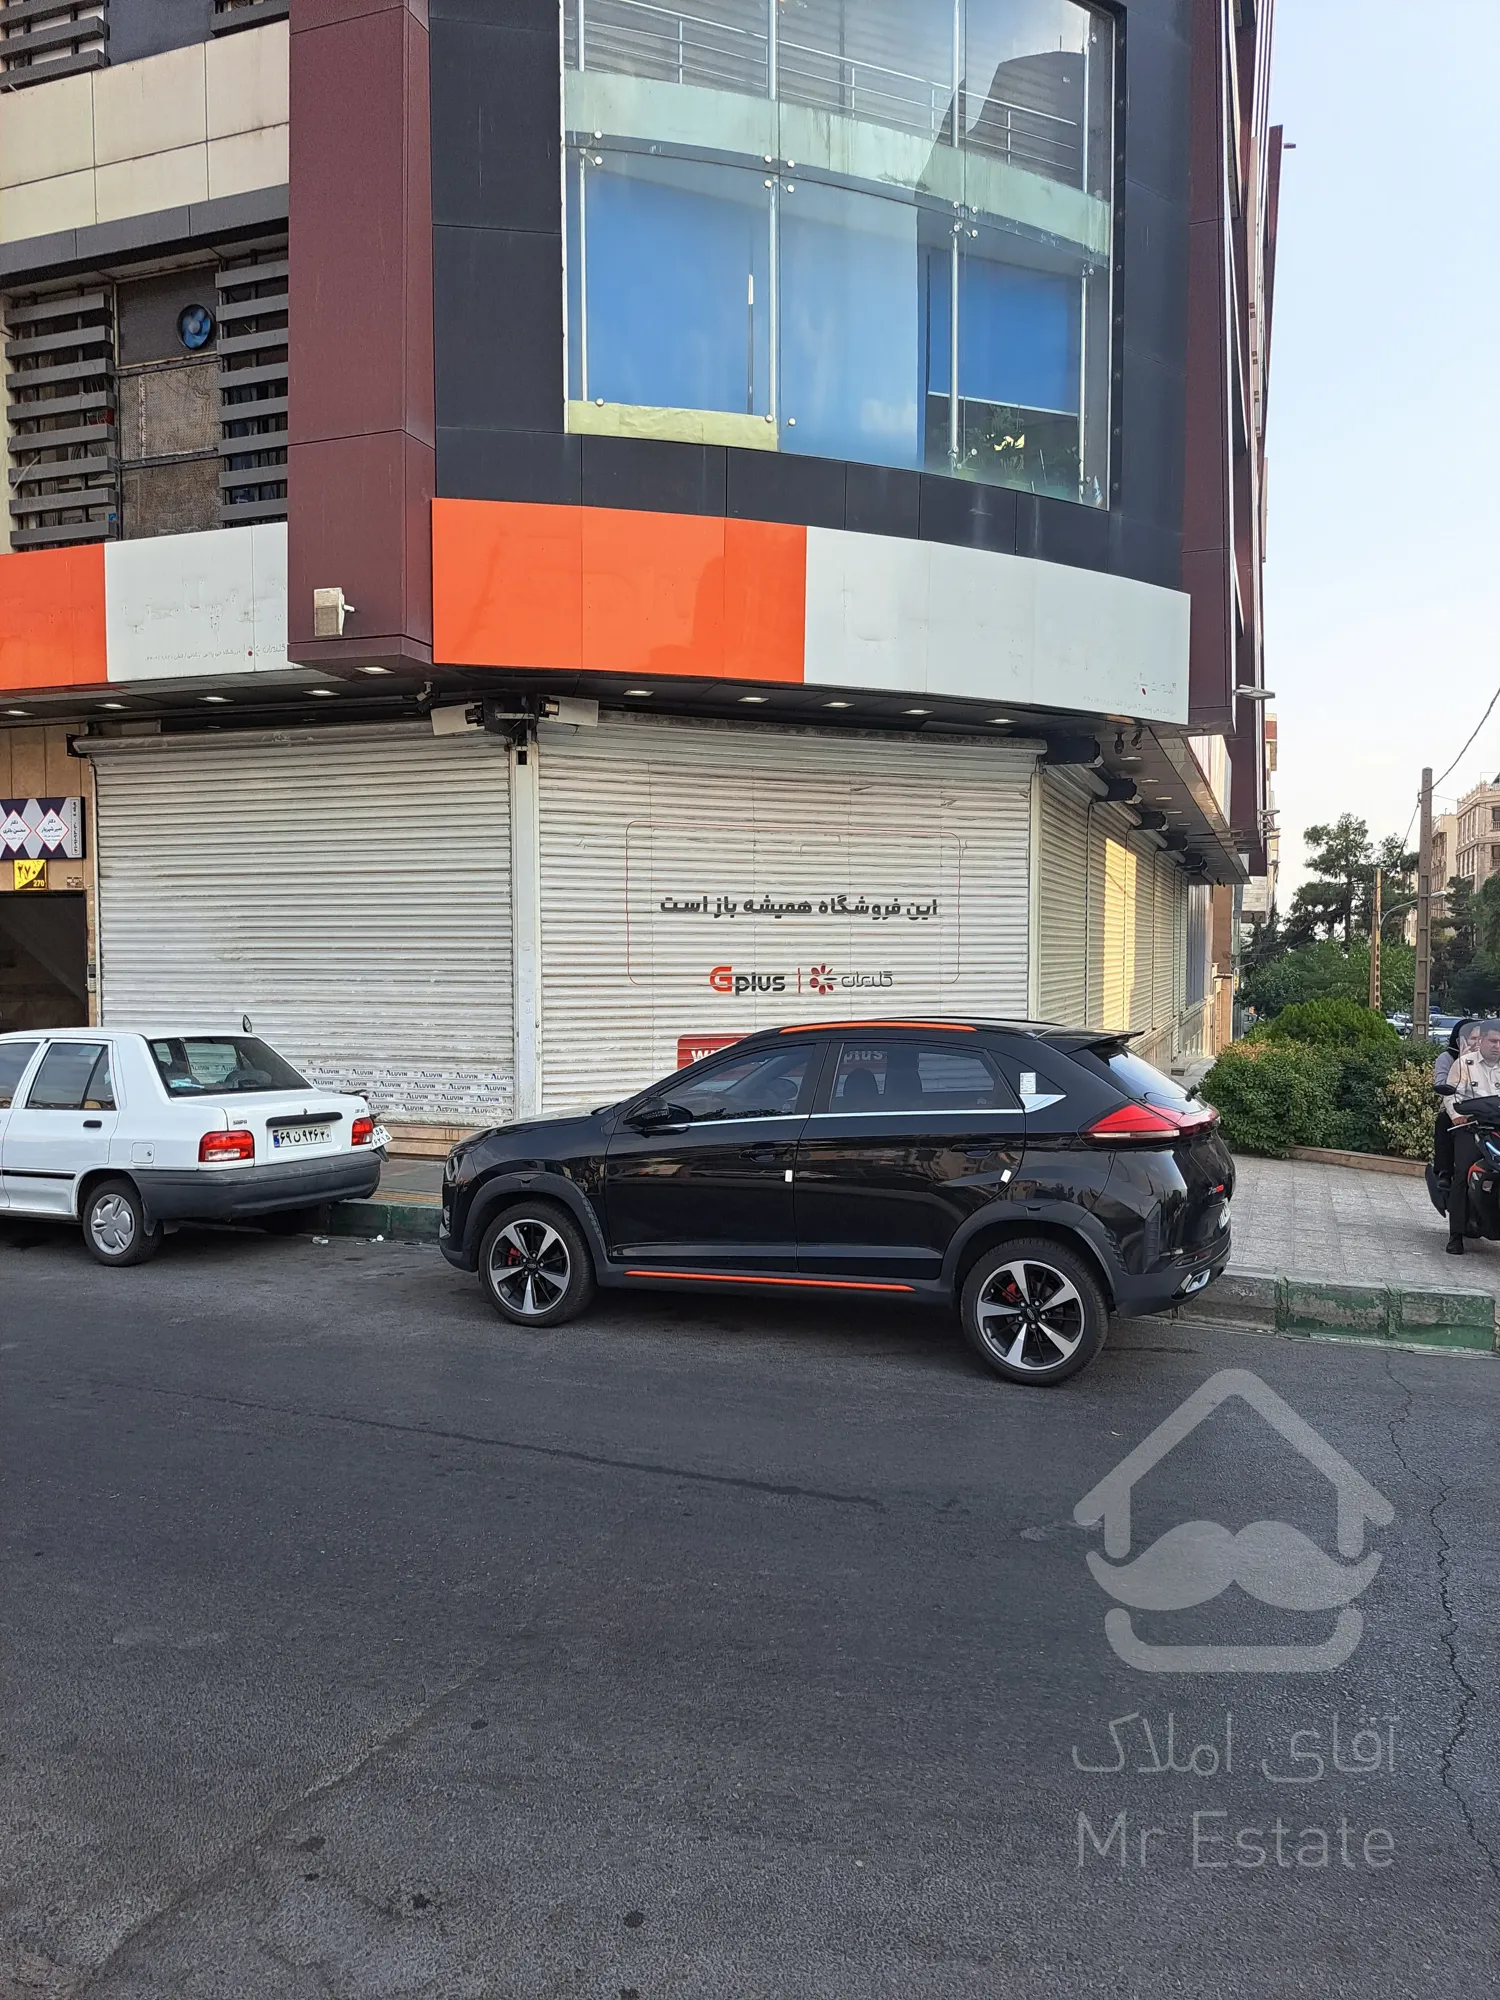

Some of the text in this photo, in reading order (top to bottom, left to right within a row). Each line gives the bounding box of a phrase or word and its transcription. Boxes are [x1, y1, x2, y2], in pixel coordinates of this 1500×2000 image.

[33, 879, 45, 887] 270
[659, 894, 938, 921] این فروشگاه همیشه باز است
[709, 965, 786, 996] Gplus
[385, 1069, 408, 1077] ALUVIN
[420, 1070, 442, 1078] ALUVIN
[312, 1078, 334, 1086] ALUVIN
[346, 1079, 368, 1087] ALUVIN
[379, 1080, 401, 1088] ALUVIN
[441, 1093, 464, 1101] ALUVIN
